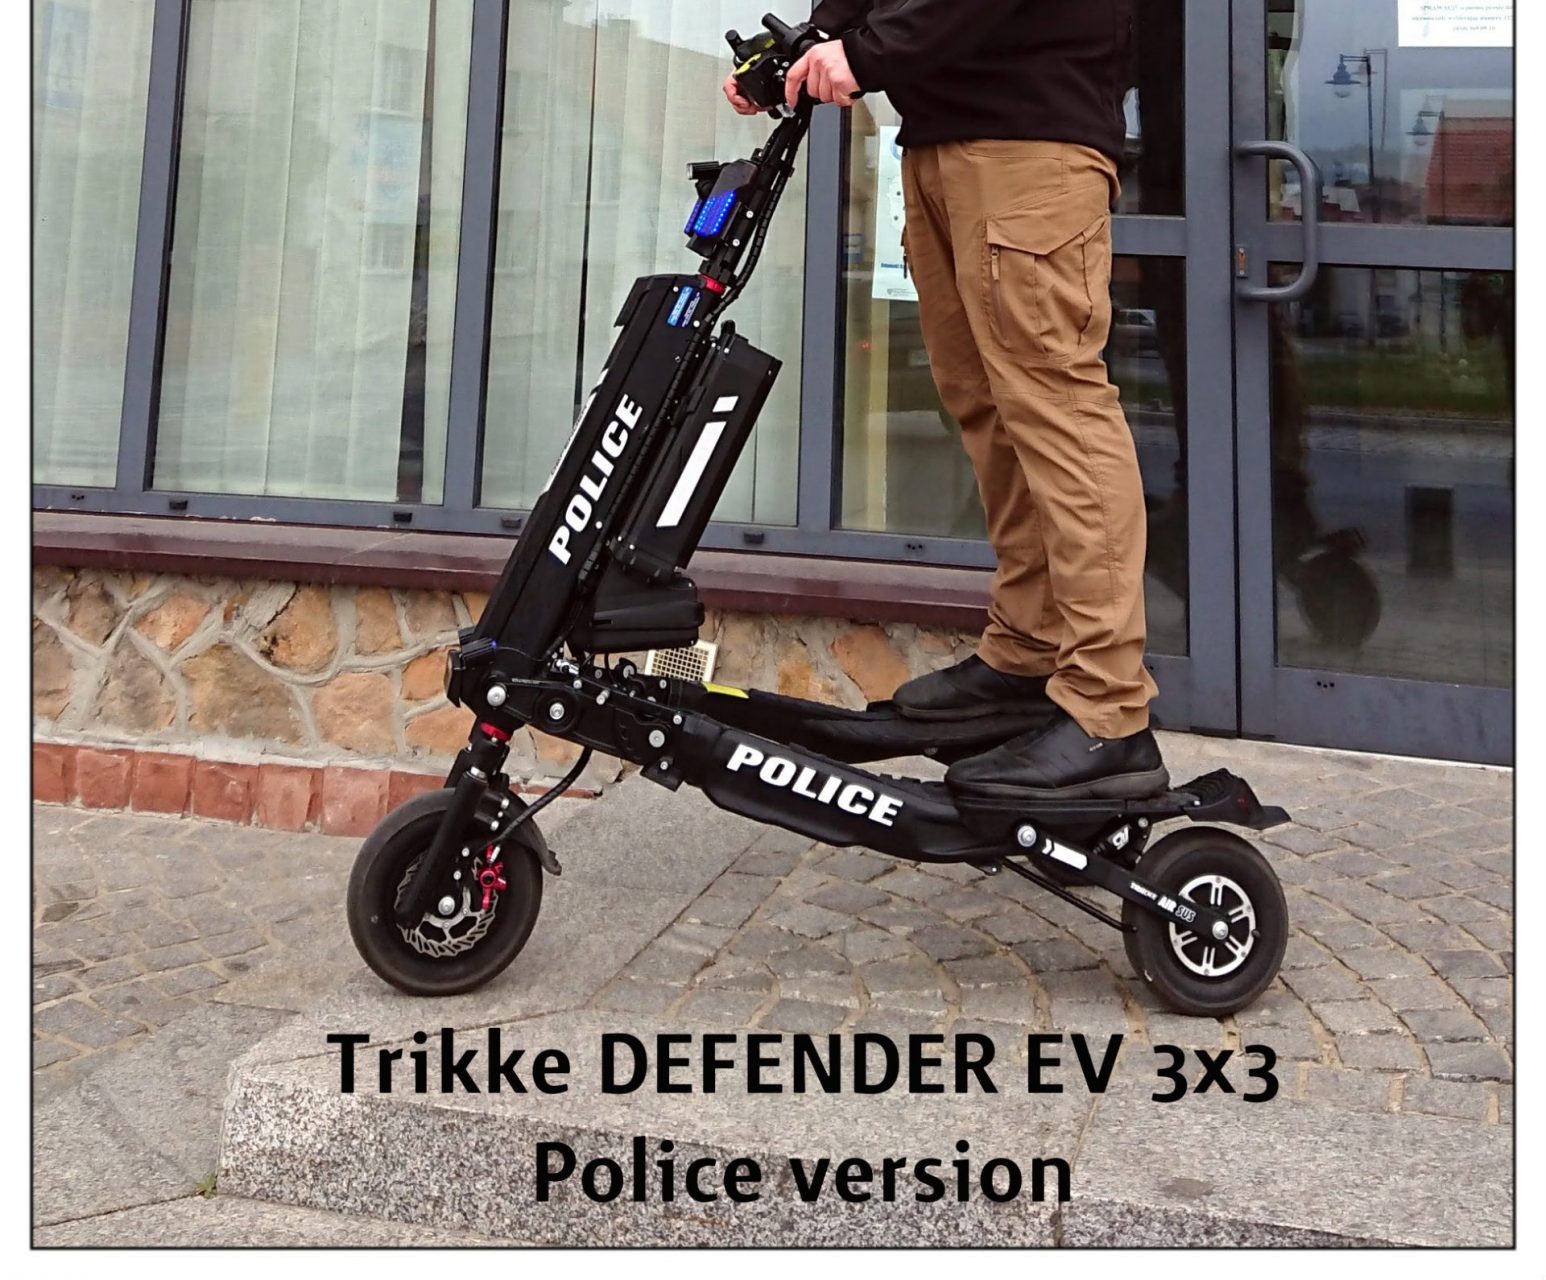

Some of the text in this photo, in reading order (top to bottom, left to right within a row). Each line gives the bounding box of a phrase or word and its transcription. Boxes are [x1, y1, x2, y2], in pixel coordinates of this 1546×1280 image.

[548, 393, 643, 565] POLICE
[726, 743, 904, 827] POLICE
[1158, 896, 1177, 912] AIR
